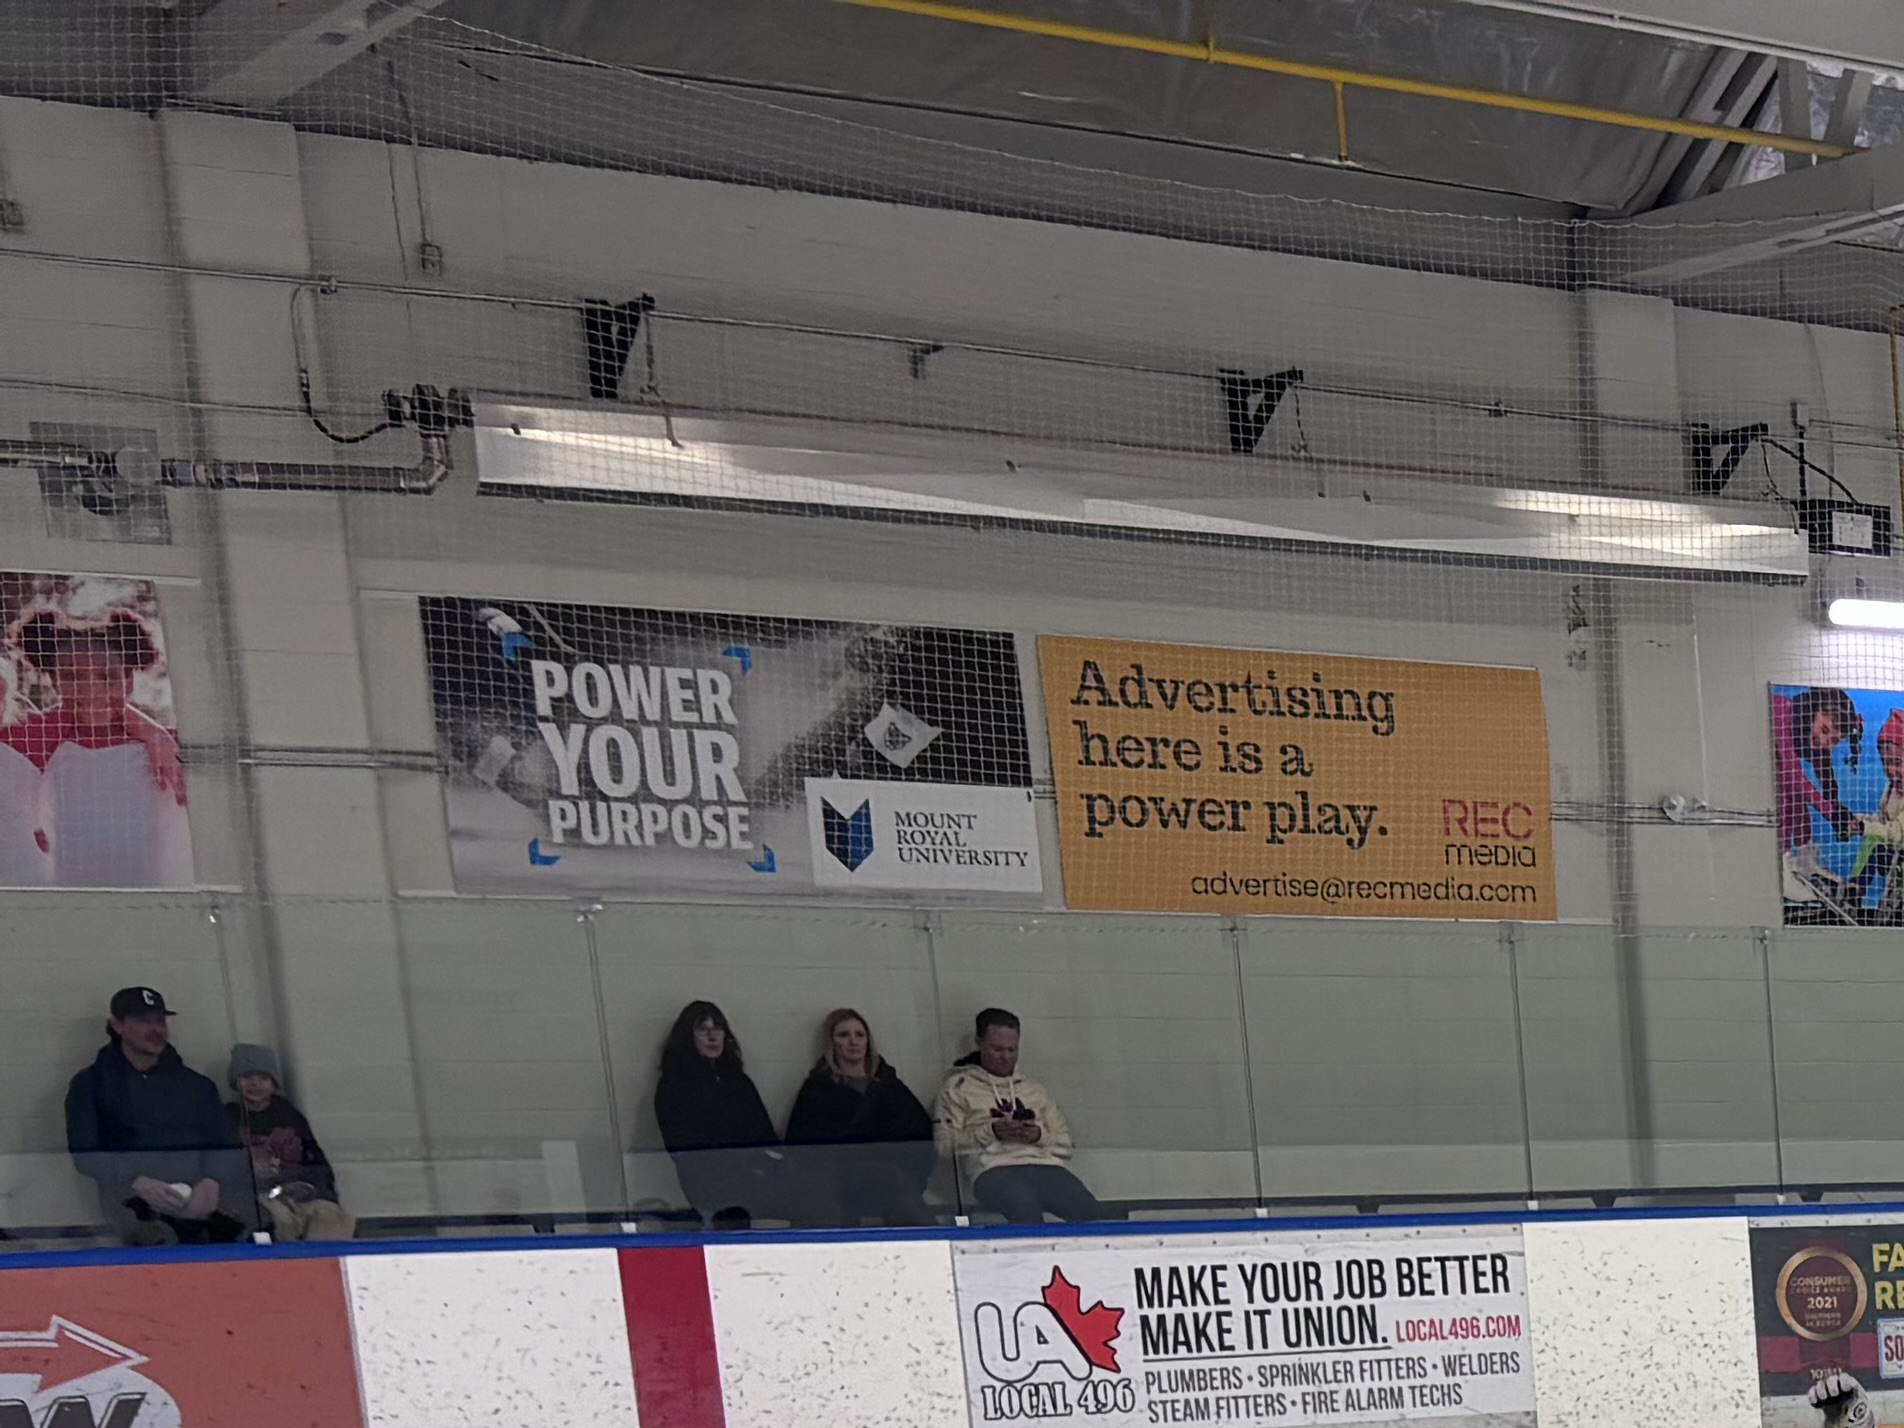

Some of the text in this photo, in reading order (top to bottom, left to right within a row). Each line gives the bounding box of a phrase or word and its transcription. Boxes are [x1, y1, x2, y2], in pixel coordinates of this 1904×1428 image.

[530, 660, 737, 726] POWER
[1070, 658, 1397, 737] Advertising
[538, 721, 747, 802] YOUR
[1076, 720, 1313, 777] here is a
[548, 801, 753, 852] PURPOSE
[894, 811, 977, 830] MOUNT
[896, 829, 969, 849] ROYAL
[1080, 789, 1390, 852] power play.
[1441, 798, 1536, 840] REC
[897, 846, 1030, 869] UNIVERSITY
[1190, 870, 1538, 907] advertise@recmedia.com
[1134, 1253, 1510, 1309] MAKE YOUR JOB BETTER
[1790, 1275, 1851, 1287] CONSUMER
[1807, 1296, 1838, 1310] 2021
[974, 1301, 1094, 1382] UA
[1140, 1303, 1522, 1357] MAKE IT UNION. LOCAL496.COM
[1144, 1351, 1521, 1395] PLUMBERS SPRINKLER FITTERS WELDERS
[981, 1378, 1136, 1421] LOCAL 496
[1148, 1383, 1463, 1424] STEAM FITTERS FIRE ALARM TECHS
